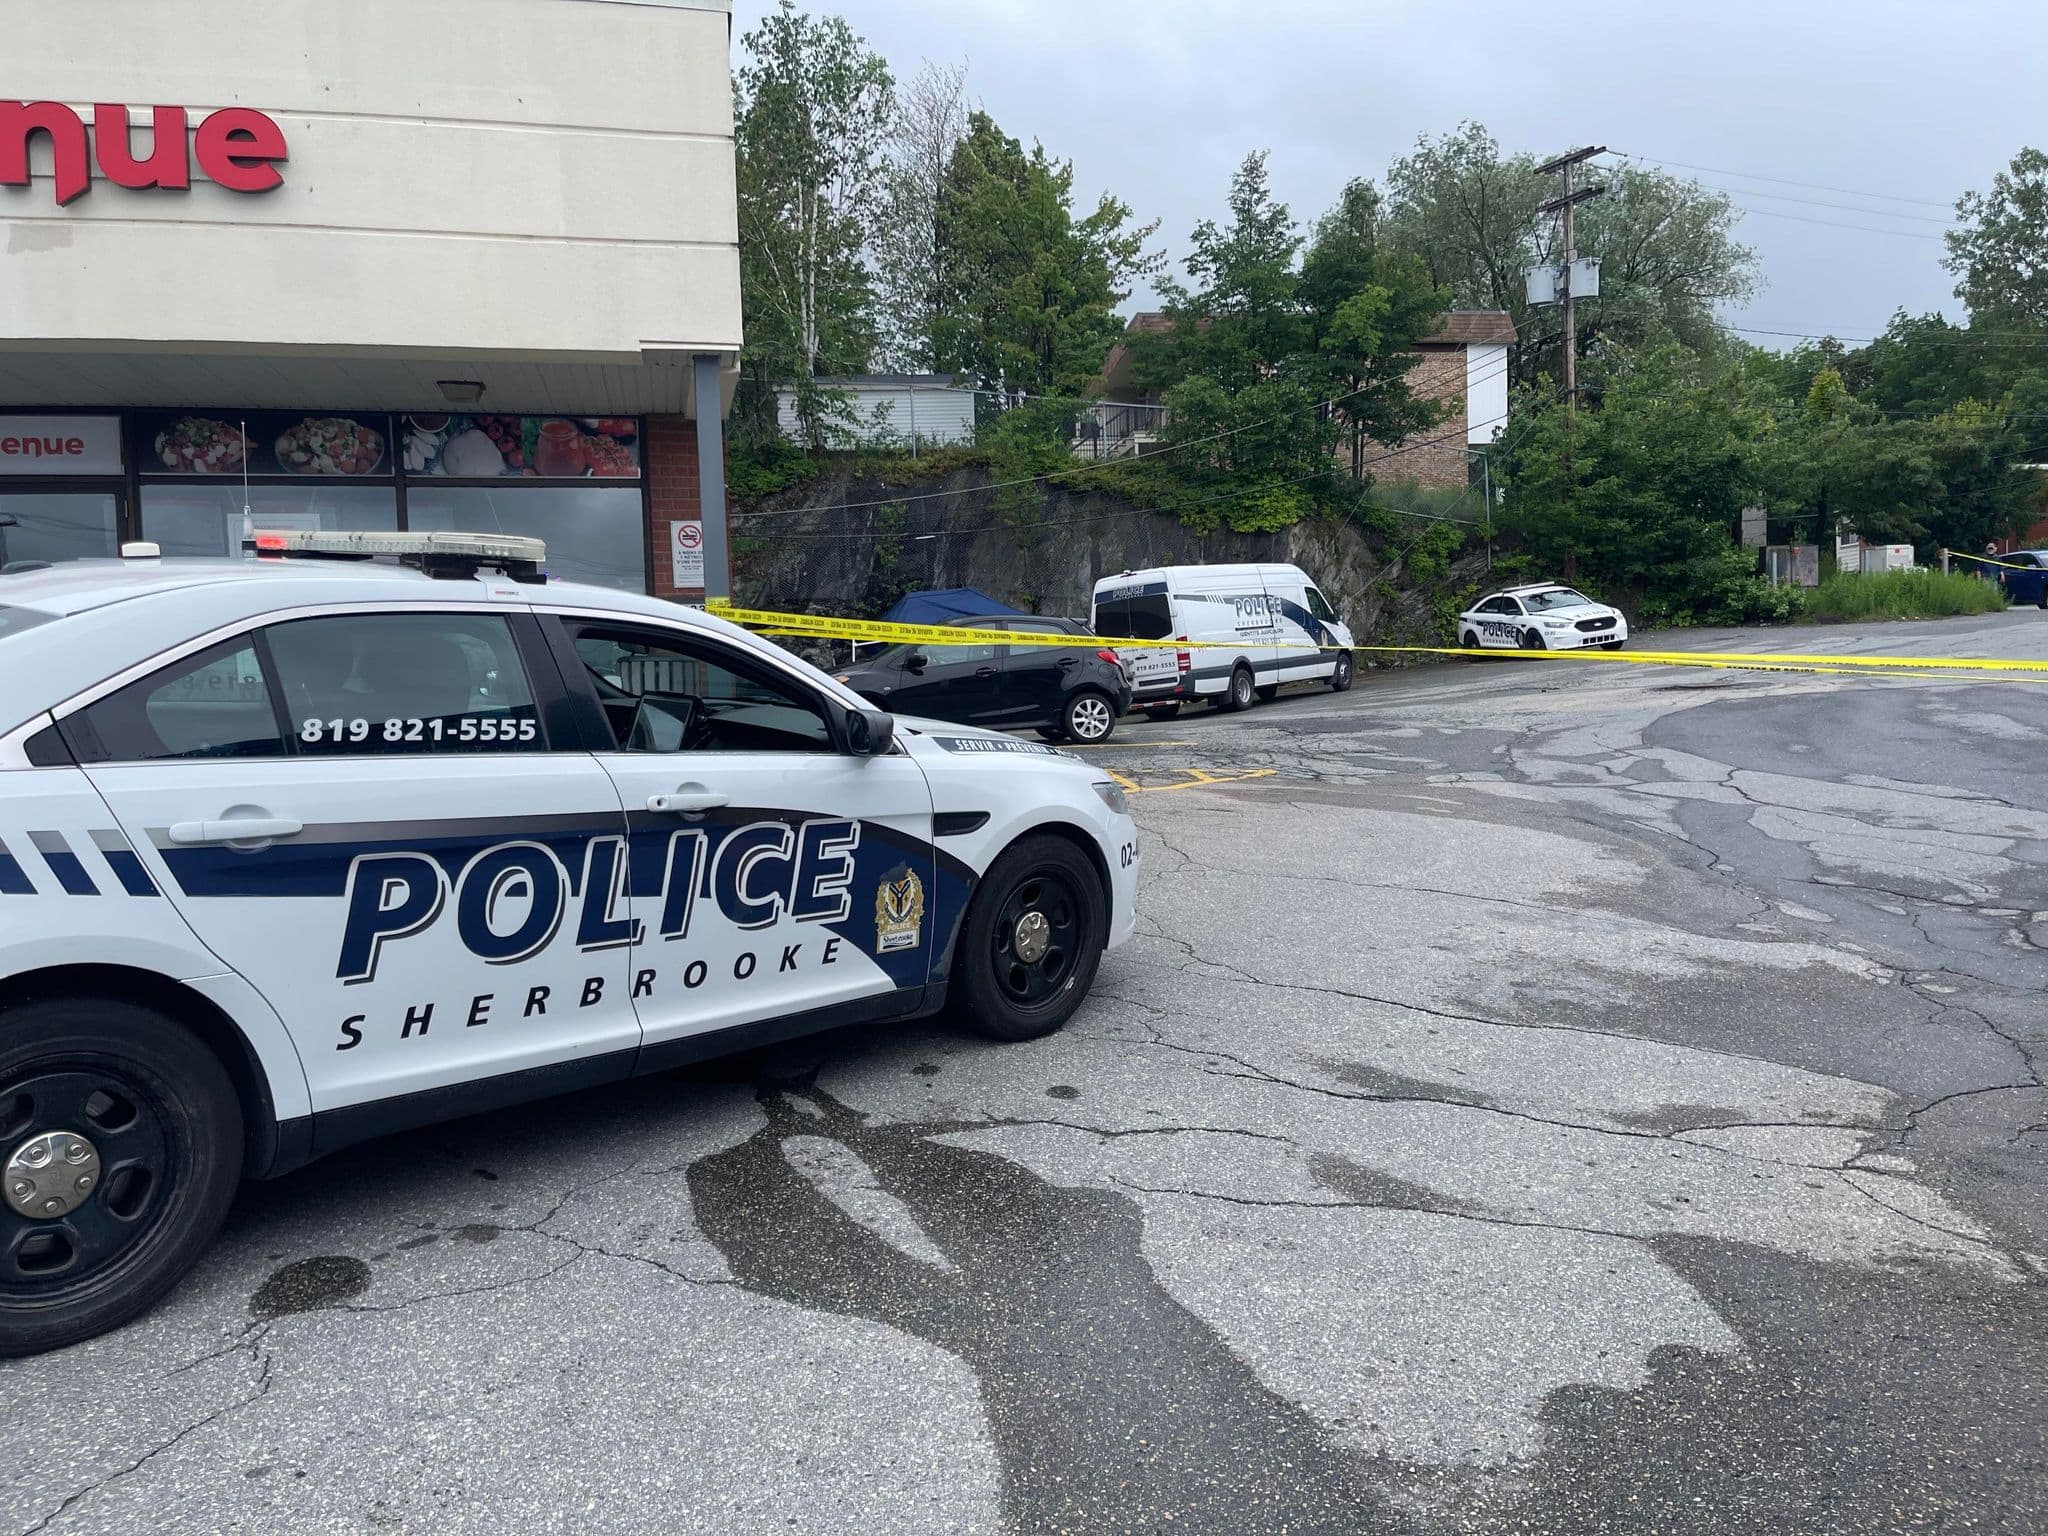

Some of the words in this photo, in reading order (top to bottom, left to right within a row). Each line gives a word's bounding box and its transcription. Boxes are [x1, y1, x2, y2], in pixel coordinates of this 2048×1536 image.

[0, 437, 85, 458] enue
[1235, 597, 1283, 617] POLICE
[1482, 623, 1517, 639] POLICE
[300, 718, 369, 742] 819
[382, 718, 536, 742] 821-5555
[955, 739, 997, 752] SERVIR
[335, 819, 861, 986] POLICE
[335, 938, 841, 1052] SHERBROOKE
